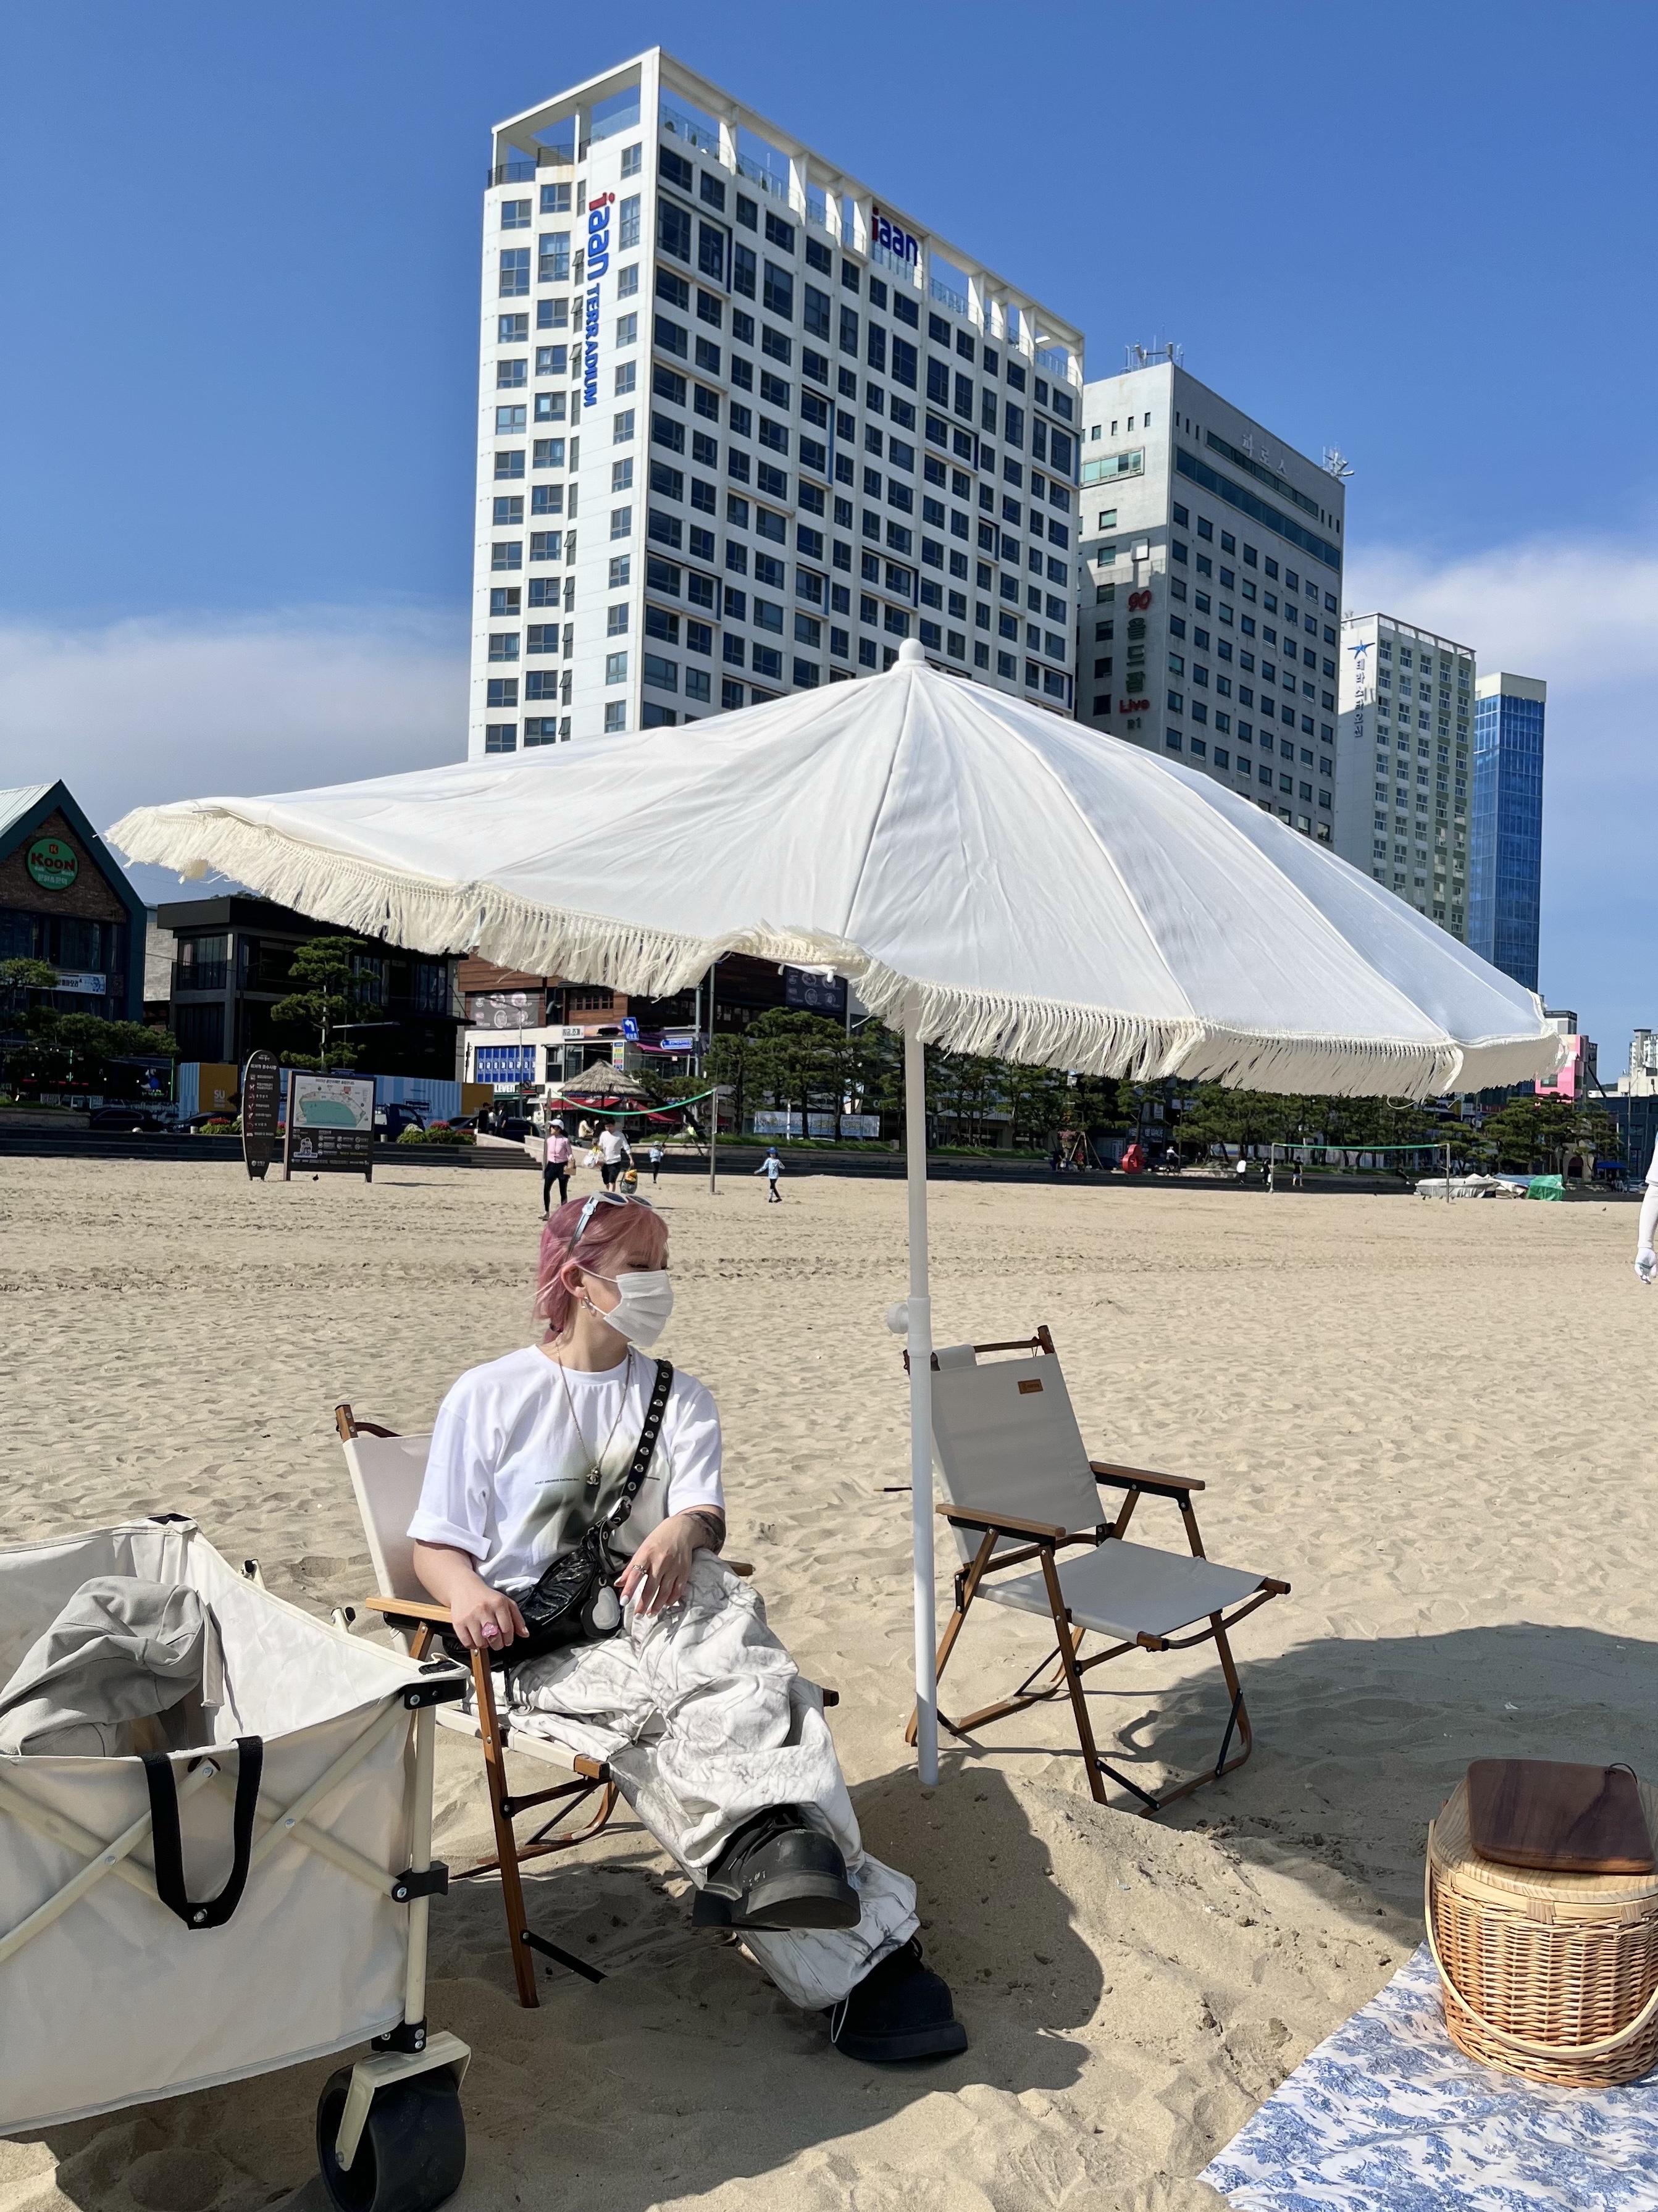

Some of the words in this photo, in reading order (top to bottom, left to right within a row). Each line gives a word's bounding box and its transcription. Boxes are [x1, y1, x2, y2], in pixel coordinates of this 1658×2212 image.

[588, 192, 614, 281] iaan
[871, 206, 918, 267] iaan
[584, 283, 600, 408] TERRADIUM
[1119, 699, 1150, 713] Live
